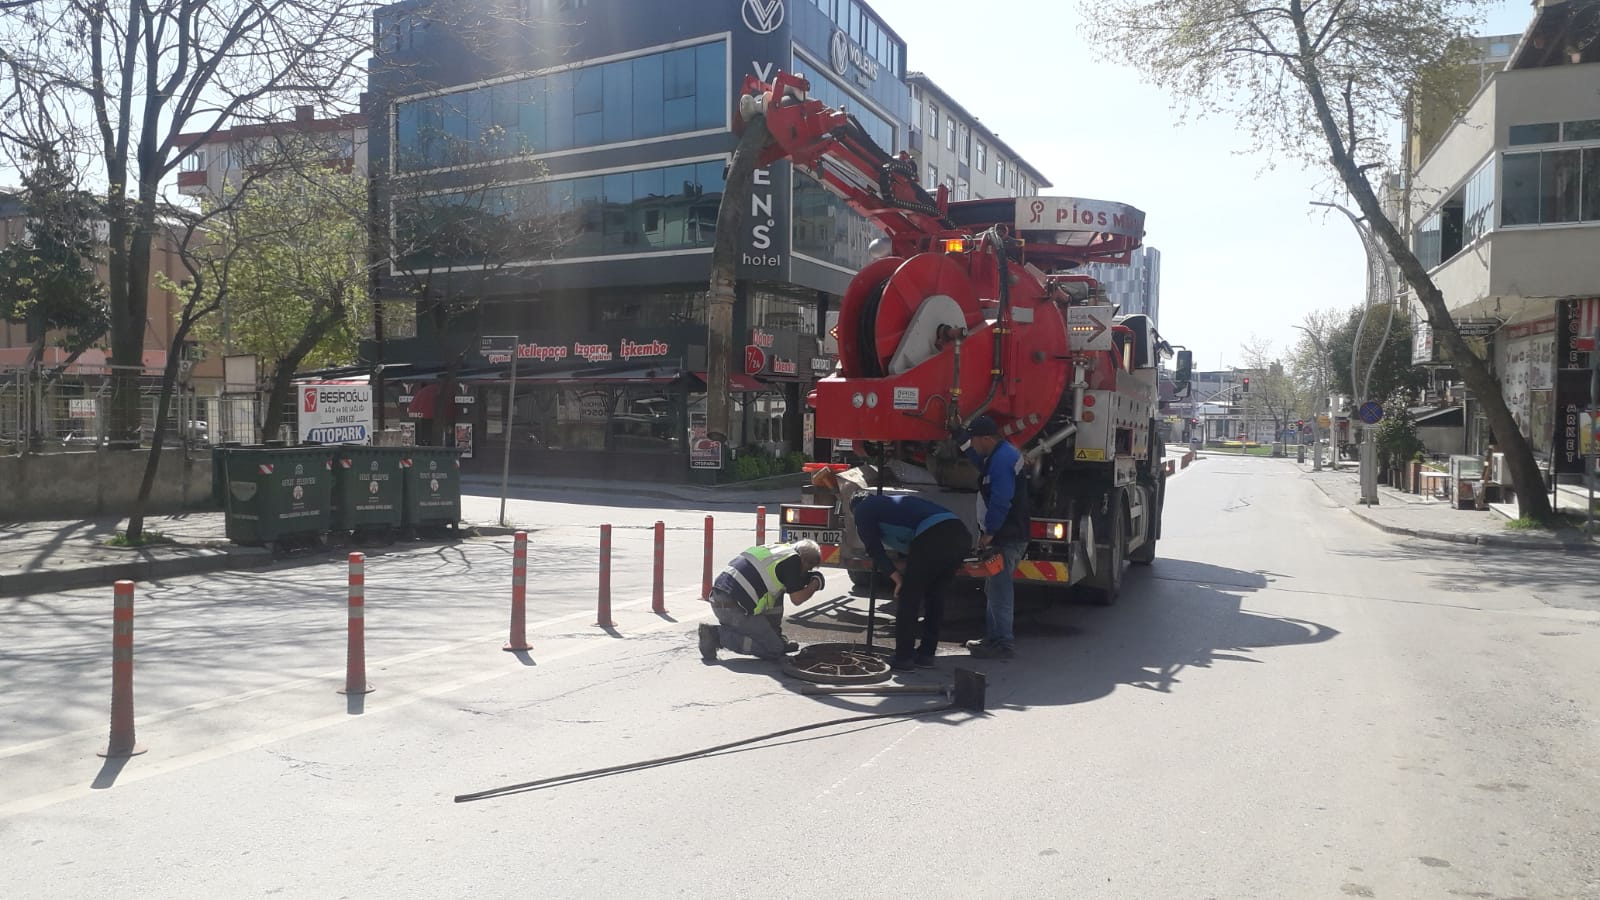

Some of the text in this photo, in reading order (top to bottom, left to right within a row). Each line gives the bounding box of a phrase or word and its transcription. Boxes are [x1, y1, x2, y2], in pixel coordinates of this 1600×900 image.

[742, 253, 781, 267] hotel
[518, 338, 668, 361] Kellepaça Izgara İşkembe
[320, 388, 369, 404] BEŞİROĞLU
[312, 426, 363, 442] OTOPARK
[787, 531, 798, 542] 34
[822, 531, 840, 543] 002
